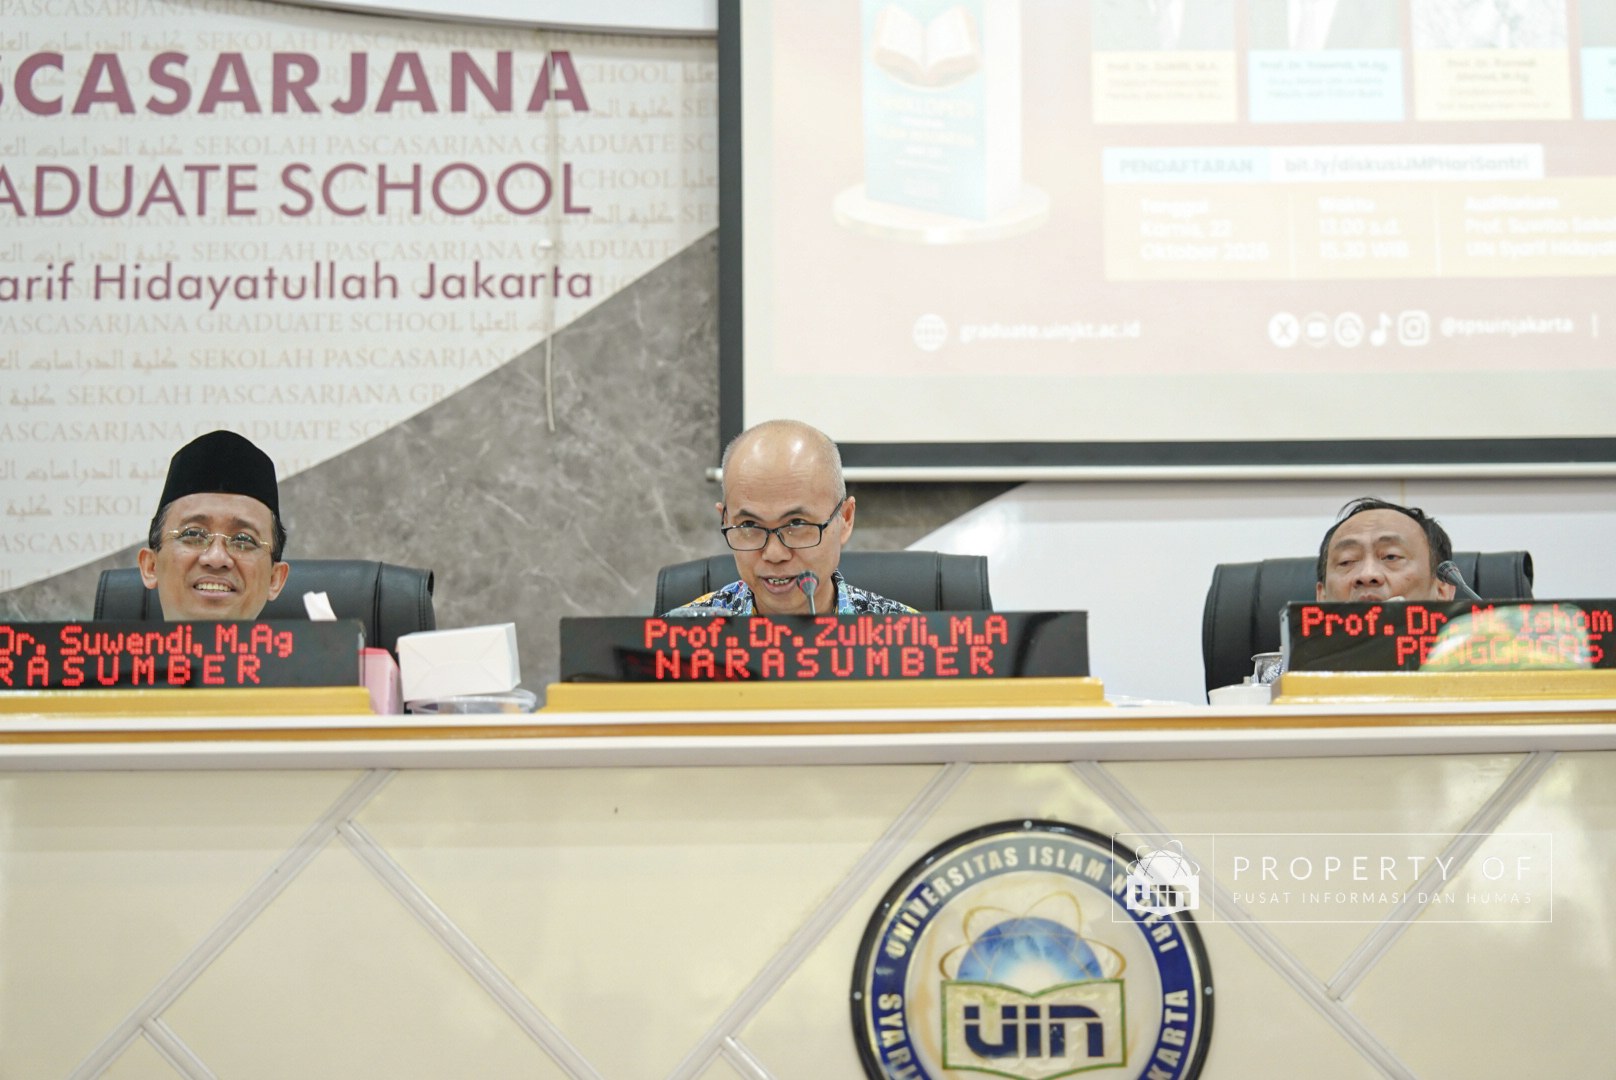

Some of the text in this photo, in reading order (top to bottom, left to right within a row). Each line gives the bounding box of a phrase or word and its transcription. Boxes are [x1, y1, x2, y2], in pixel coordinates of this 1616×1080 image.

[0, 50, 589, 116] CASARJANA
[1118, 158, 1253, 173] PENDAFTARAN
[279, 161, 592, 217] SCHOOL
[94, 259, 399, 311] Hidayatullah
[418, 259, 593, 300] Jakarta
[644, 614, 1008, 650] Prof. Dr. Zulkifli, M.A
[1301, 606, 1394, 637] Prof.
[1406, 605, 1459, 636] Dr.
[1519, 603, 1613, 634] Ishom
[60, 625, 203, 658] Suwendi,
[215, 624, 293, 658] M.Ag
[655, 644, 995, 680] NARASUMBER
[885, 847, 1020, 959] UNIVERSITAS
[1029, 846, 1106, 881] ISLAM
